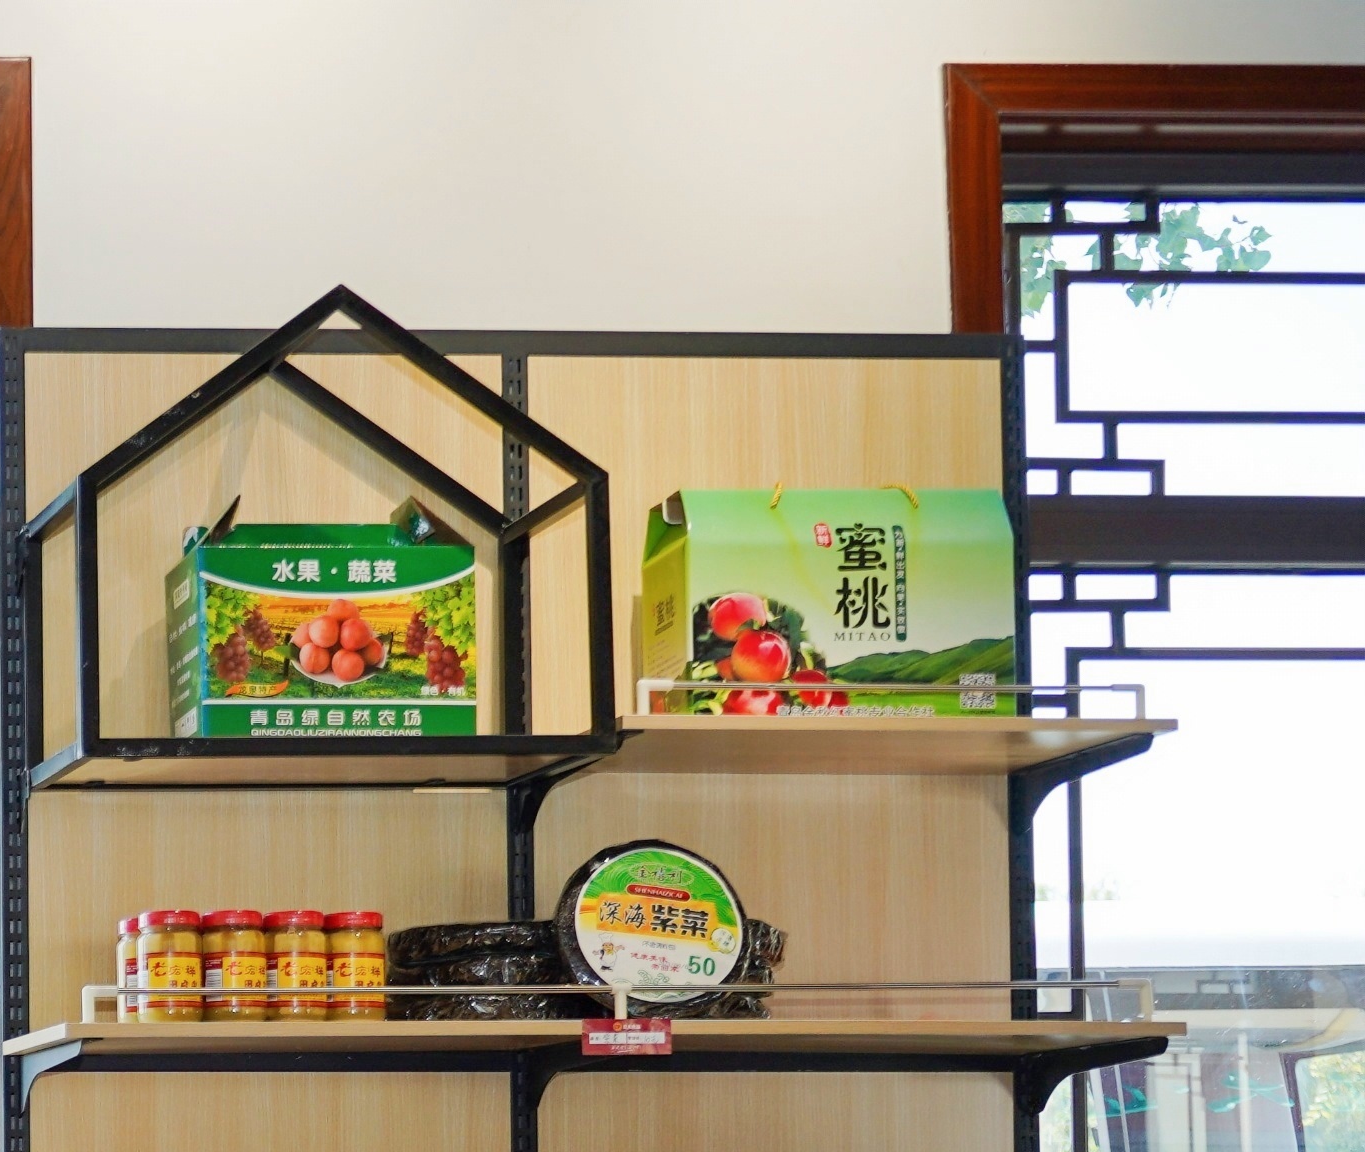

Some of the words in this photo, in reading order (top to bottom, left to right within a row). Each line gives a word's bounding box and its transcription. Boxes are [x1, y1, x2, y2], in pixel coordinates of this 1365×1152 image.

[272, 559, 397, 583] 水果·蔬菜
[834, 522, 891, 629] 蜜桃
[834, 632, 891, 642] MITAO
[250, 709, 423, 726] 青岛绿自然农场
[599, 901, 709, 938] 深海紫菜
[688, 955, 716, 976] 50
